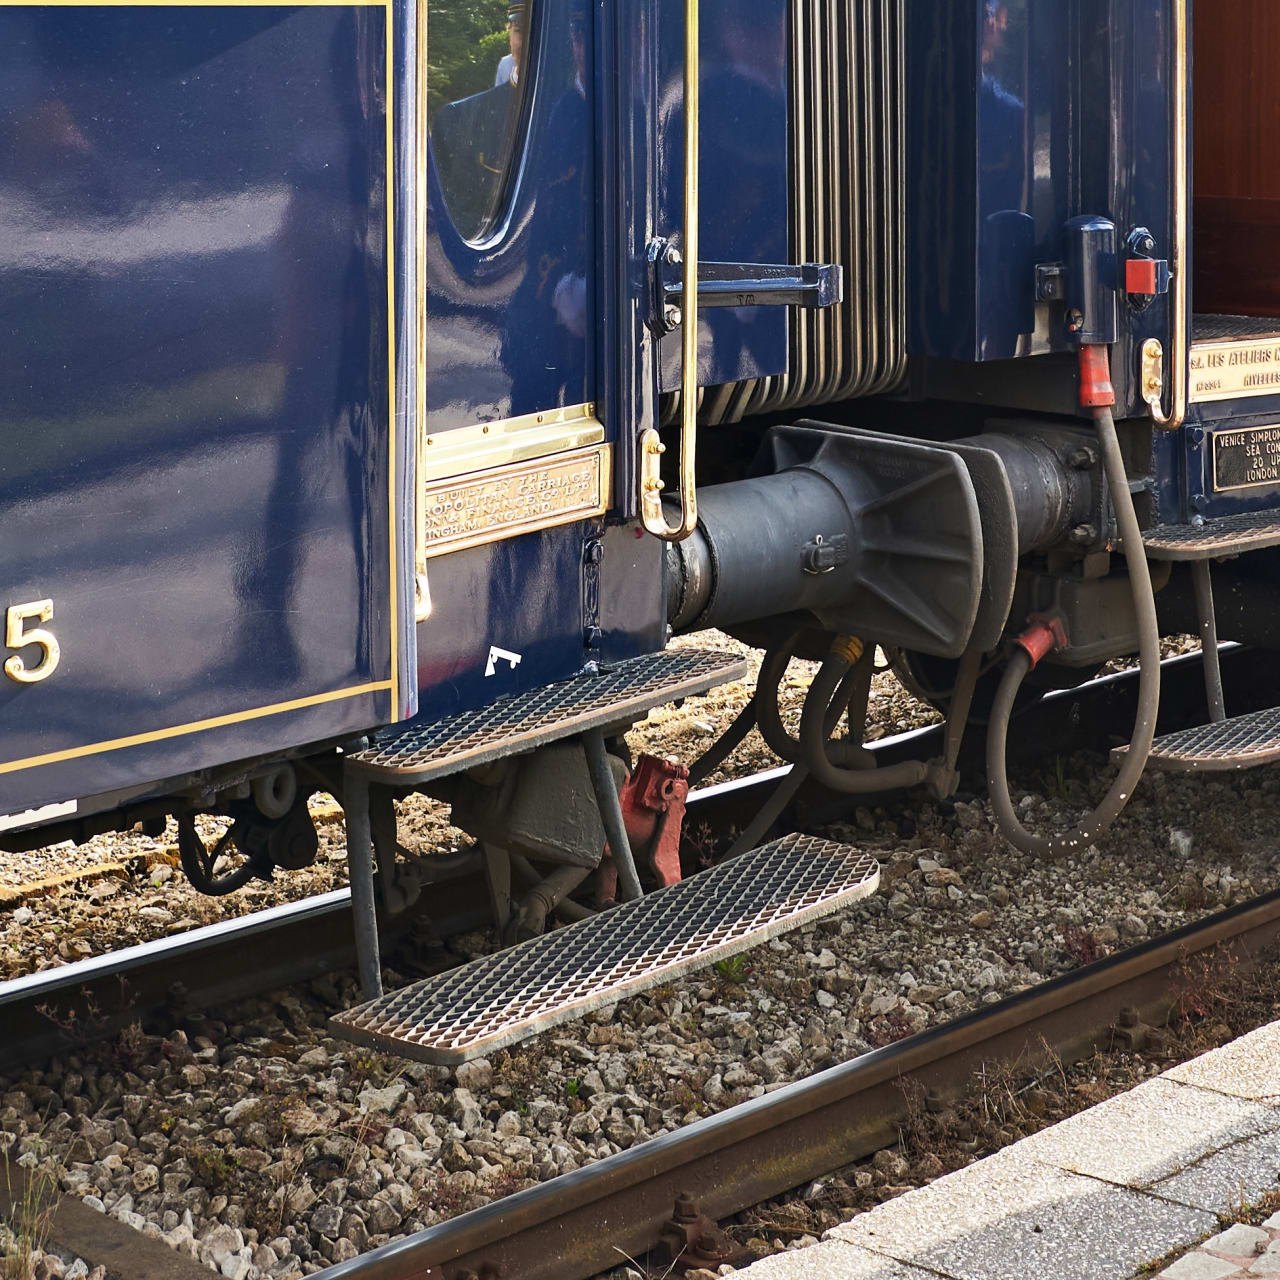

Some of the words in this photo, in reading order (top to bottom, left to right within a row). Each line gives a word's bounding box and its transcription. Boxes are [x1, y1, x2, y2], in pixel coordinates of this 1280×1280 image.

[1207, 352, 1224, 368] LES
[1228, 348, 1271, 366] ATELIERS
[1220, 434, 1245, 448] VENICE
[1246, 444, 1261, 457] SEA
[1253, 457, 1263, 469] 20
[1246, 468, 1278, 482] LONDON
[437, 486, 485, 503] BUILT
[495, 479, 513, 491] BY
[519, 471, 548, 485] THE
